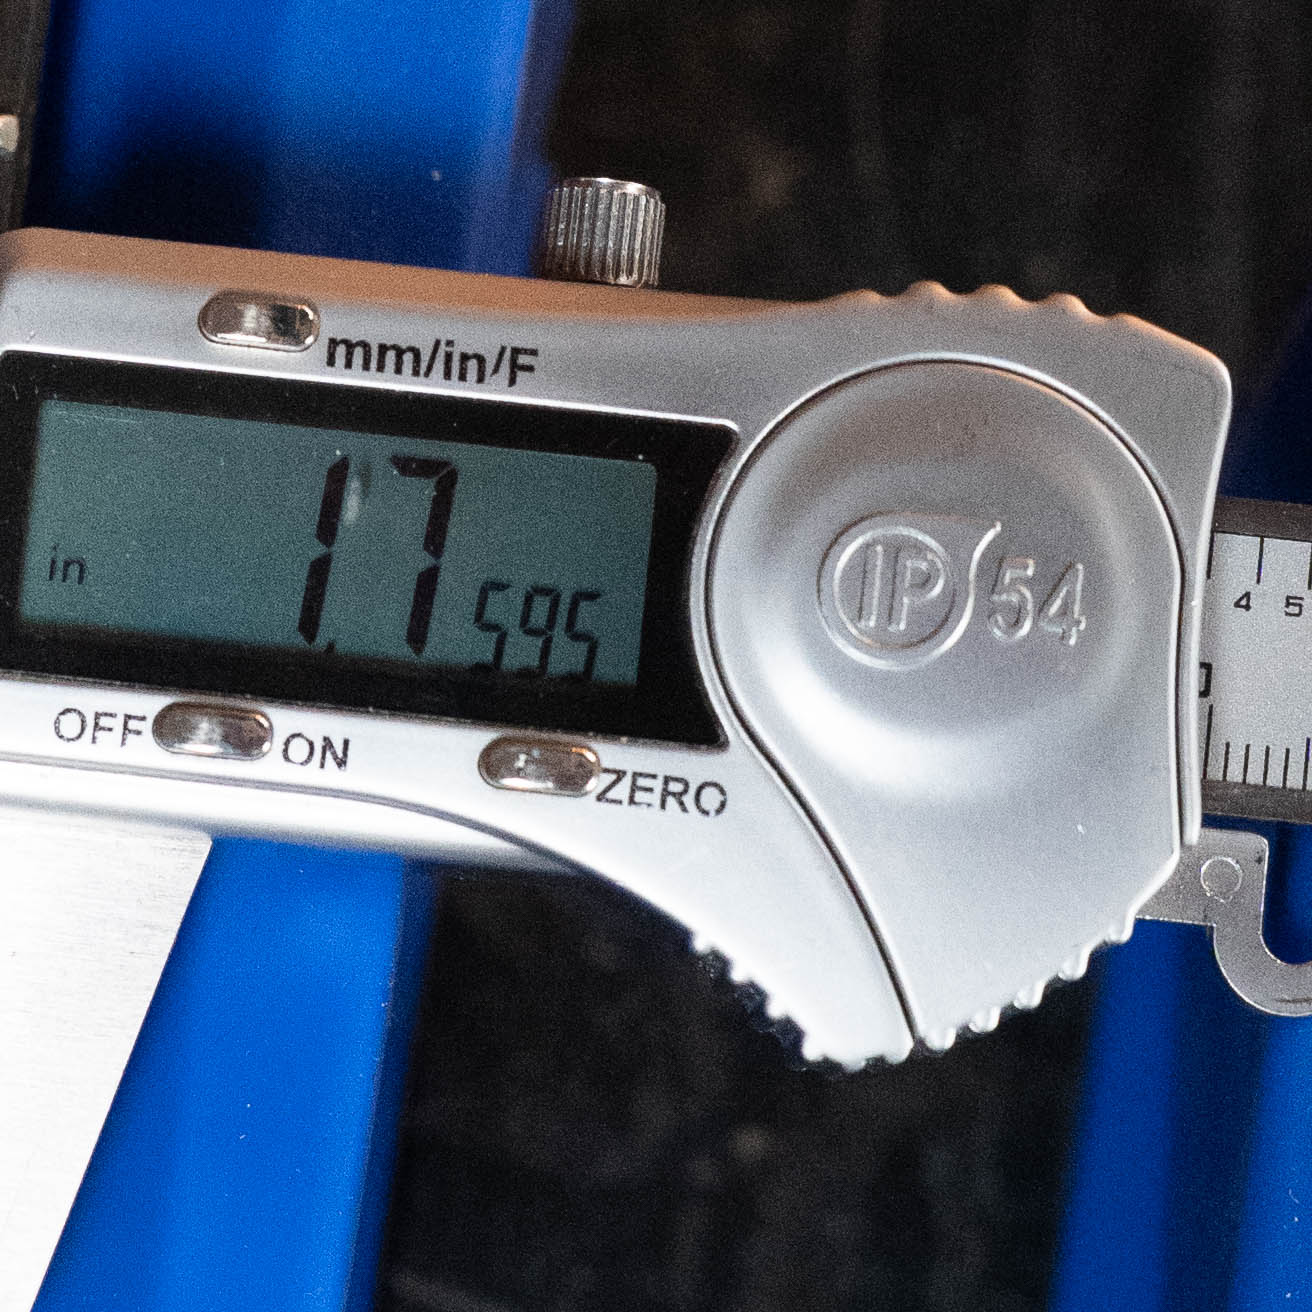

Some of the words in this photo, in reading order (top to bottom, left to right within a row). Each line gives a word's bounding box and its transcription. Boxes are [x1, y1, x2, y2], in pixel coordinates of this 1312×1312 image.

[326, 337, 538, 387] mm/in/F
[48, 545, 86, 584] in
[857, 543, 946, 632] IP
[991, 556, 1087, 647] 54
[1234, 592, 1251, 611] 4
[1285, 595, 1304, 617] 5
[54, 708, 147, 746] OFF
[282, 733, 350, 769] ON
[595, 768, 727, 818] ZERO
